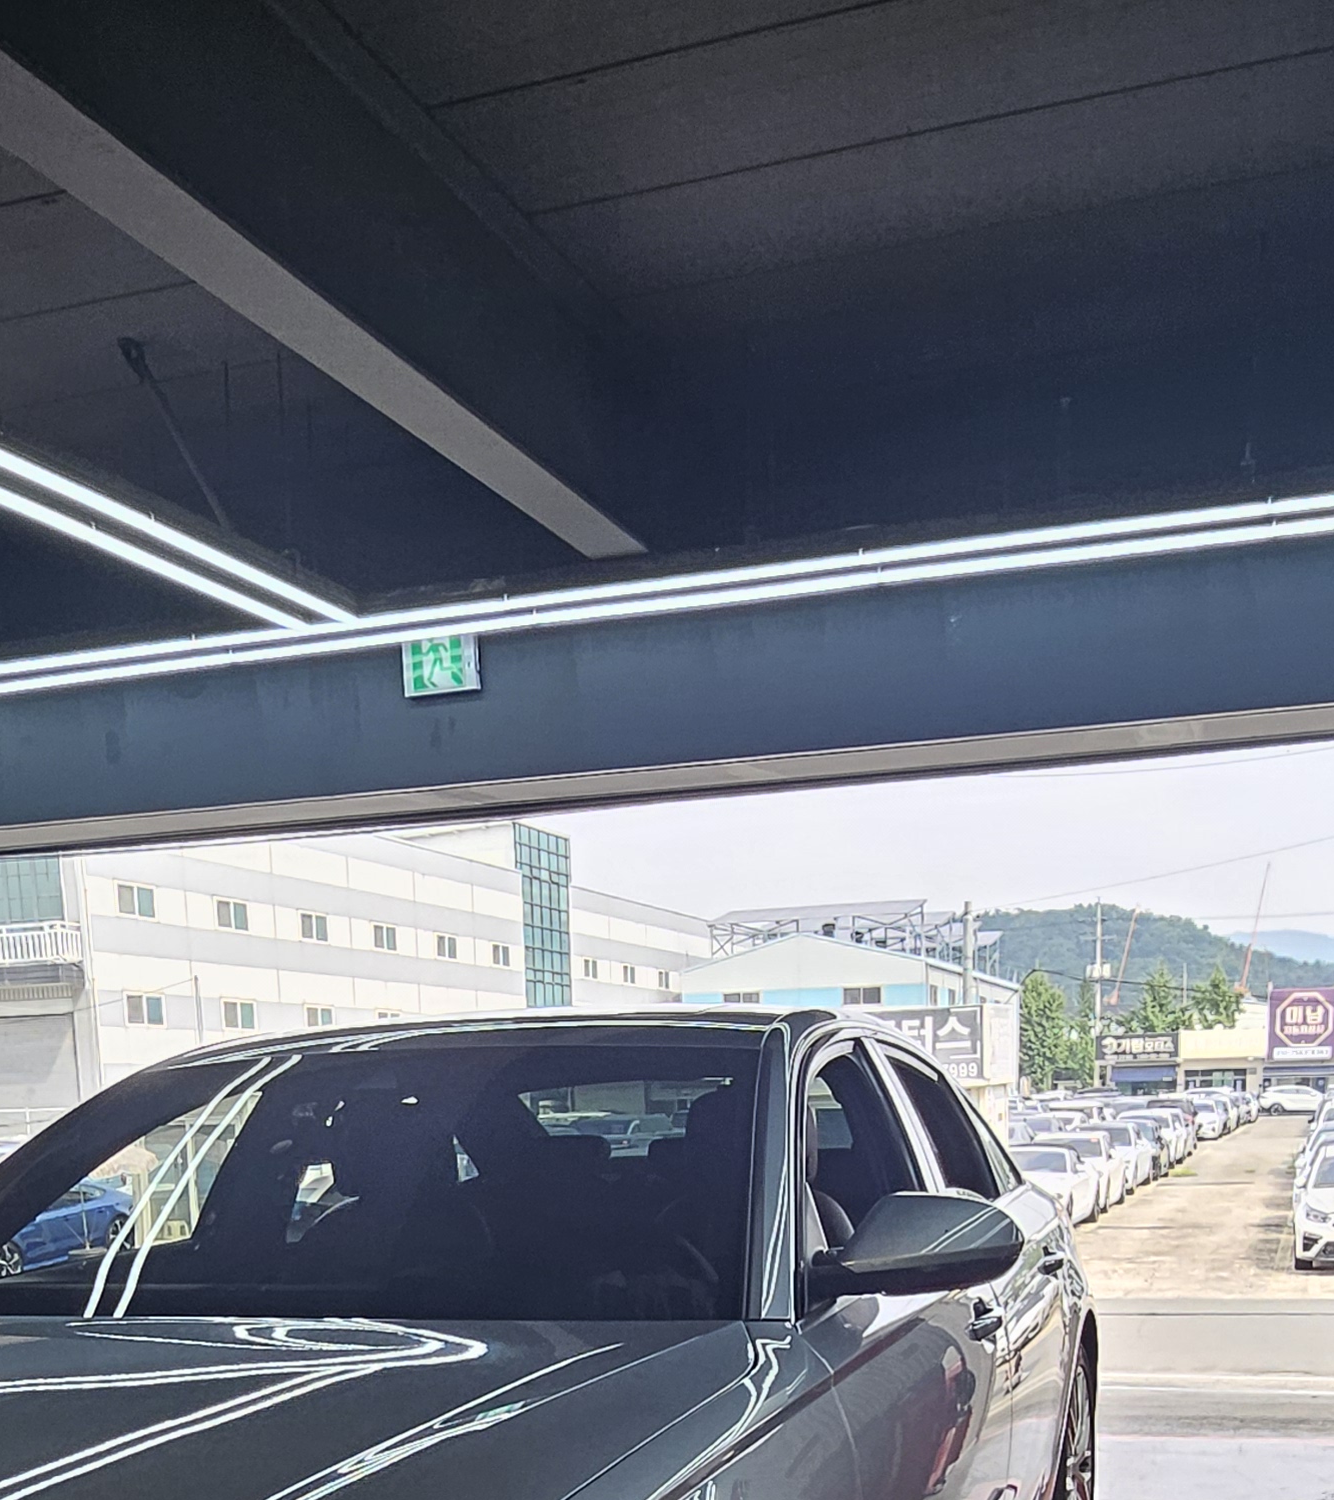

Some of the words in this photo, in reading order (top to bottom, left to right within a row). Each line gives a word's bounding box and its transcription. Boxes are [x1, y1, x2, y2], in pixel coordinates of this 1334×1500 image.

[1285, 1005, 1325, 1024] 미남
[881, 1015, 971, 1056] 터스
[944, 1062, 978, 1077] 999
